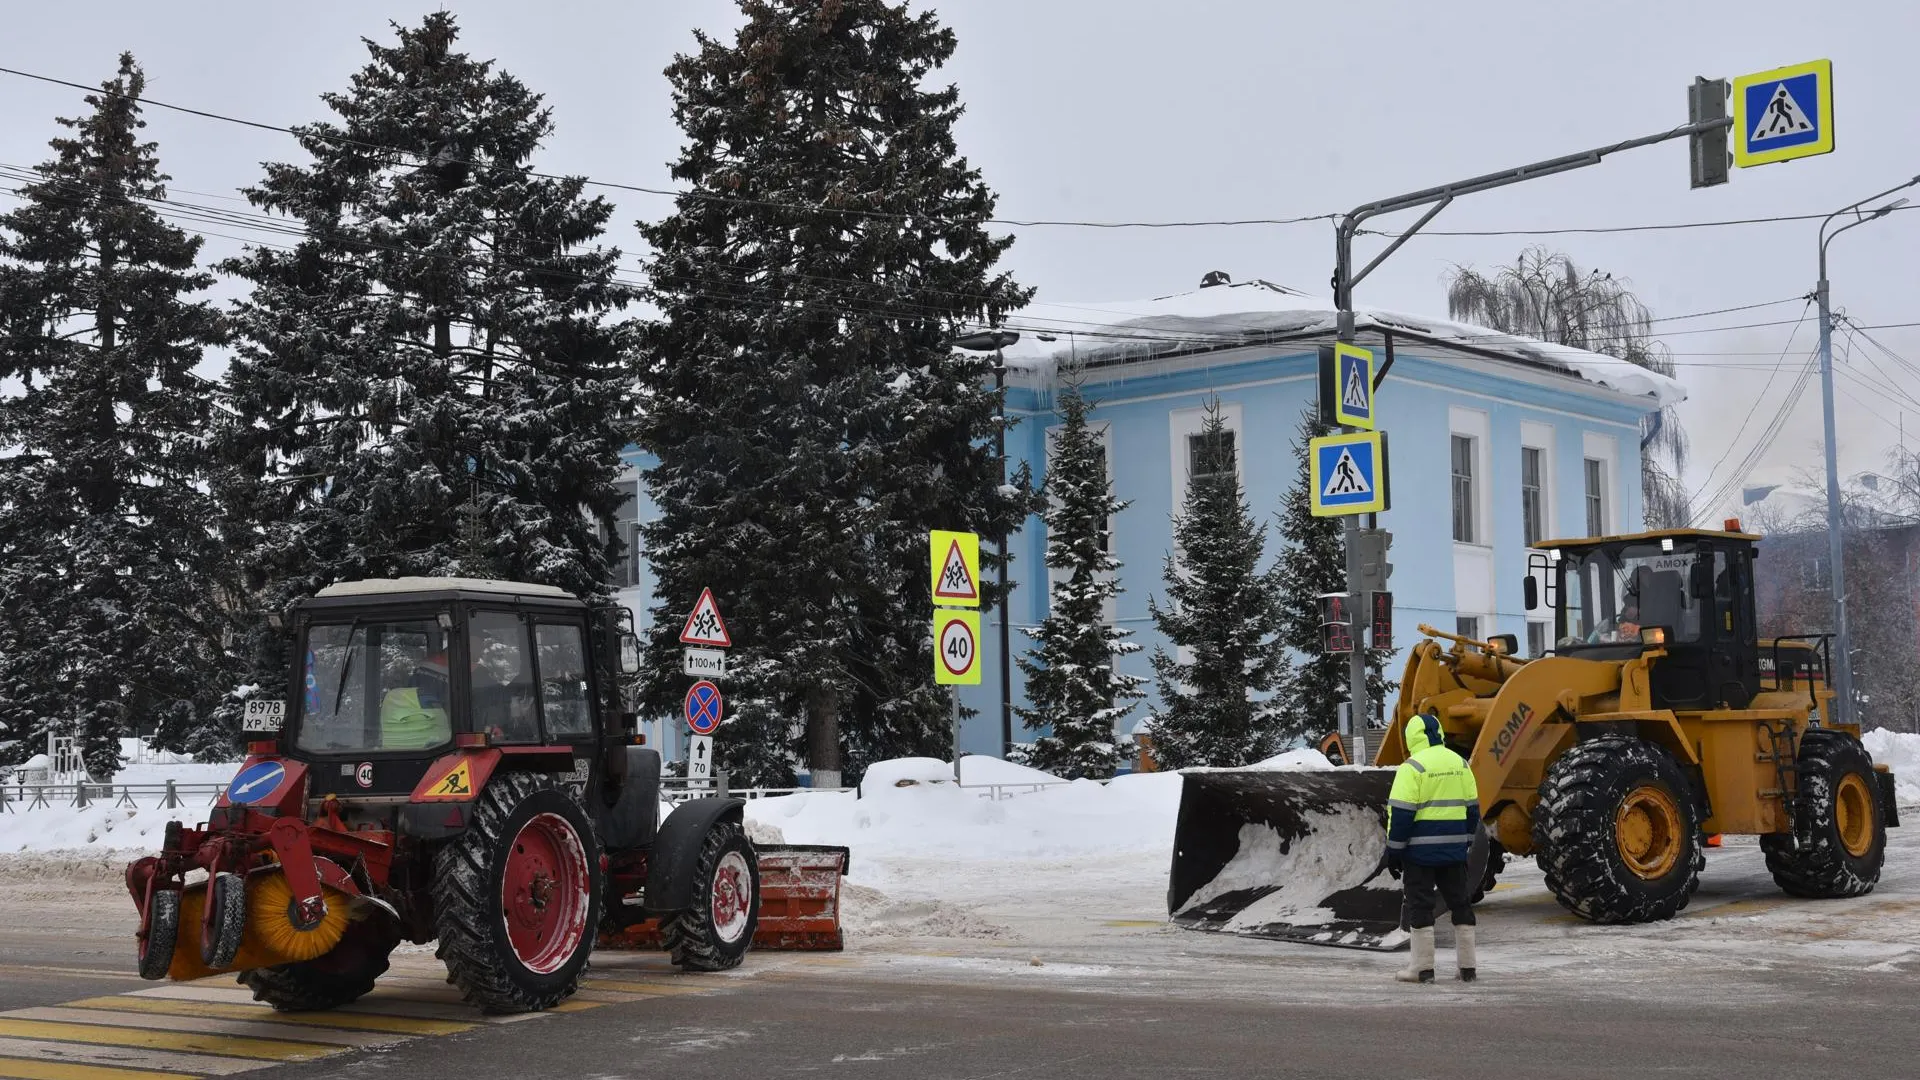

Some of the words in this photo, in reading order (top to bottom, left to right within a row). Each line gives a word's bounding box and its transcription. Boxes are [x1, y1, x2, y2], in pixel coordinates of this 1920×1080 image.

[948, 637, 968, 658] 40
[250, 701, 280, 714] 8978
[246, 719, 262, 729] ХР
[269, 716, 281, 726] 50
[1488, 701, 1532, 762] XGMA
[694, 762, 706, 774] 70
[360, 769, 373, 781] 40
